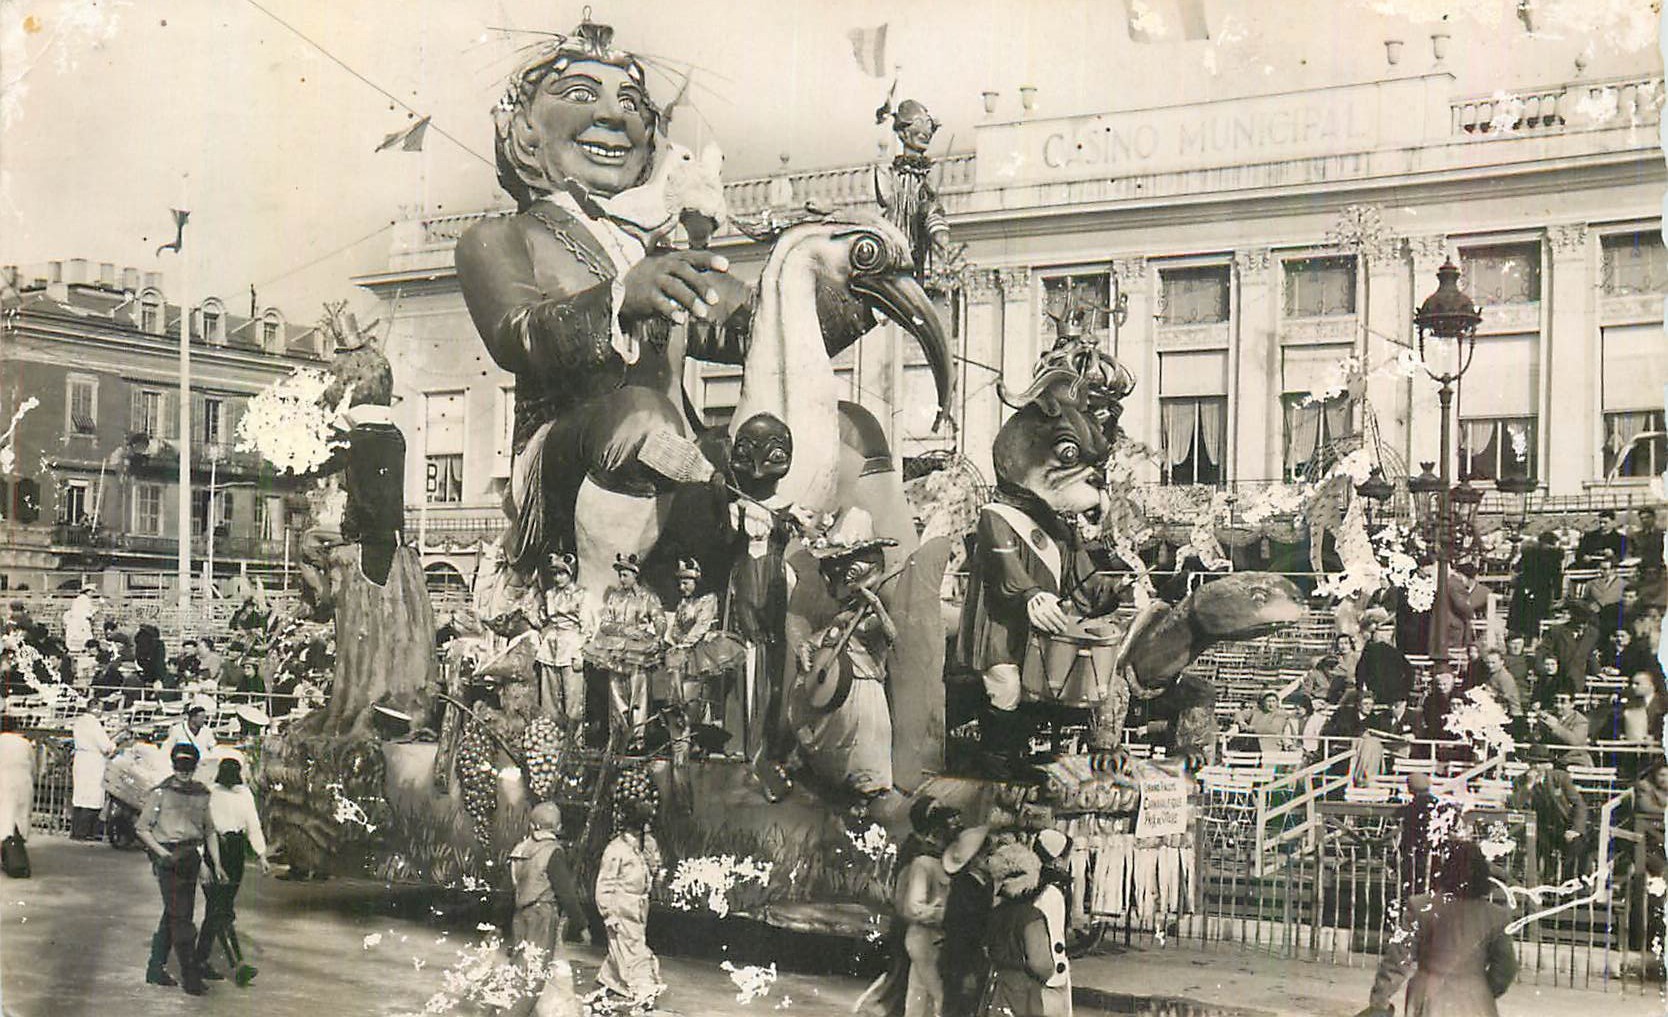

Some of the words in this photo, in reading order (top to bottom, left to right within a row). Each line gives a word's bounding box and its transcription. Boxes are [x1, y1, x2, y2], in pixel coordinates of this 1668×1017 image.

[1042, 124, 1159, 169] CASINO
[1179, 101, 1367, 156] MUNICIPAL
[426, 462, 438, 493] B
